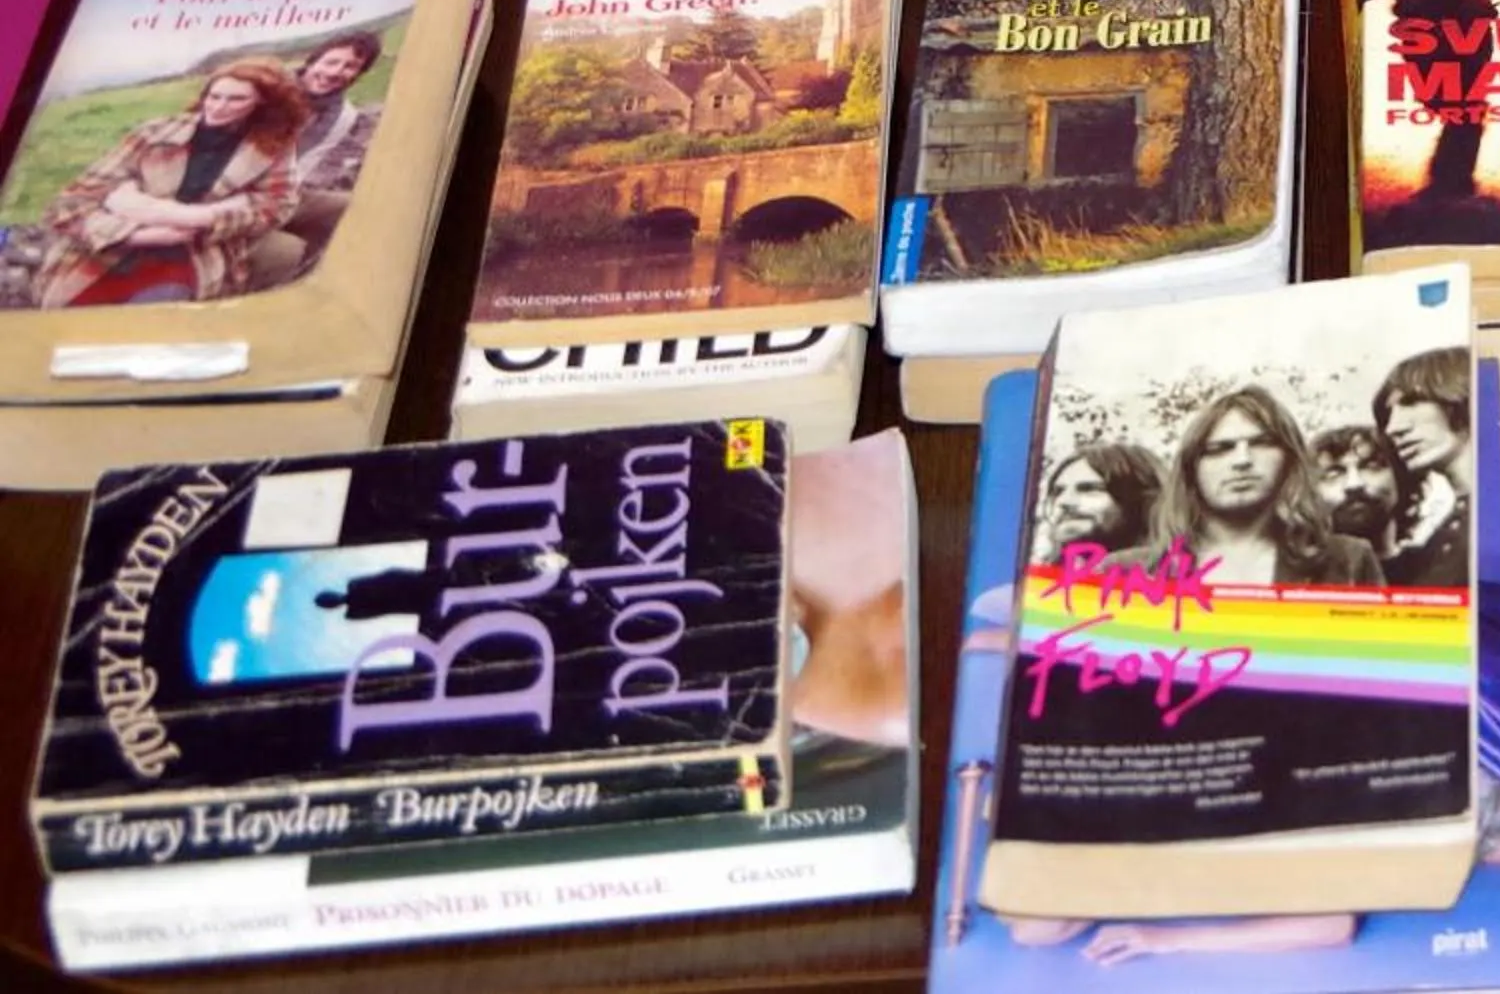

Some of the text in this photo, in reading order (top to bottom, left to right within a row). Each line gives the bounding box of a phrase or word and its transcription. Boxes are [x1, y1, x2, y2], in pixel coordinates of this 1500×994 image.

[132, 4, 351, 31] et le meilleur
[994, 8, 1211, 52] Bon Grain
[1028, 1, 1057, 18] et
[340, 440, 568, 751] Bur-
[603, 436, 728, 716] pojken
[1042, 536, 1223, 631] PINK
[98, 467, 229, 778] TOREY HAYDEN
[1028, 614, 1250, 727] FLOYD
[74, 776, 600, 862] Torey Hayden Burpojken
[313, 893, 489, 927] PRISONNIER
[555, 876, 671, 905] DOPAGE
